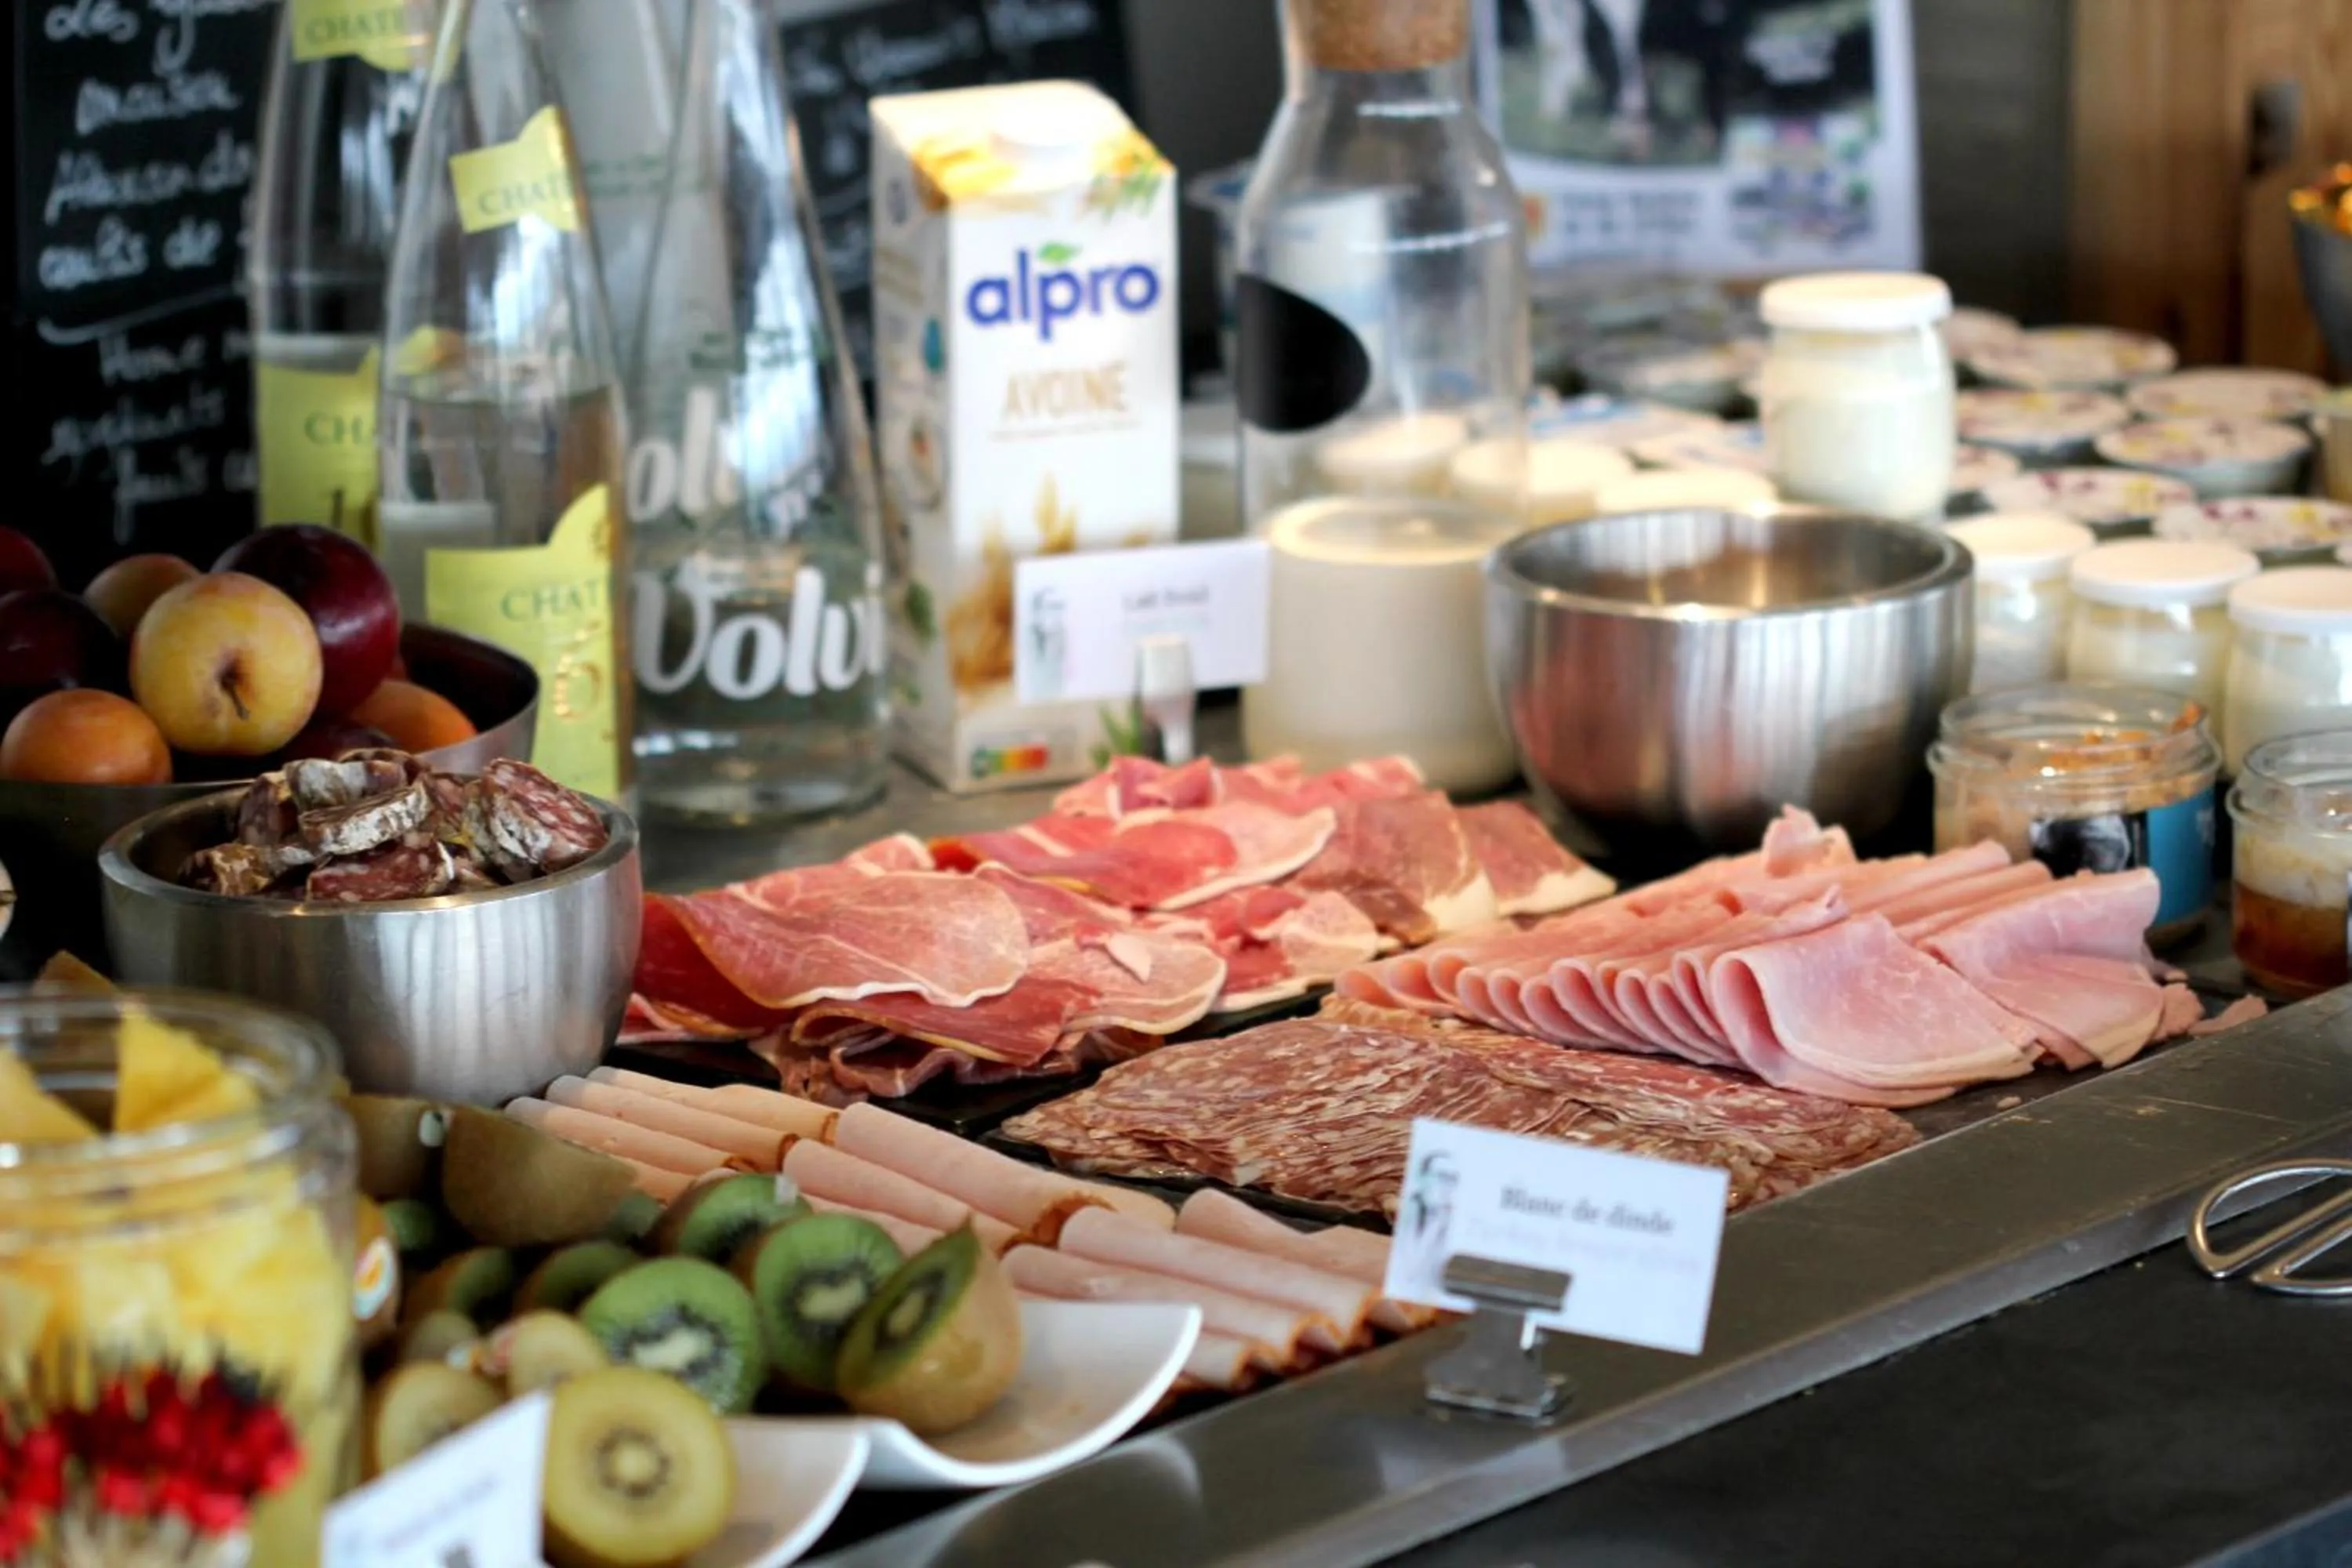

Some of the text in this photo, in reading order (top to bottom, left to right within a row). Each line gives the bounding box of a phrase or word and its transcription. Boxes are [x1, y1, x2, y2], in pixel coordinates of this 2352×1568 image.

[966, 246, 1161, 343] alpro
[1004, 359, 1130, 422] AVOINE
[1499, 1184, 1677, 1236] Blanc de dinde
